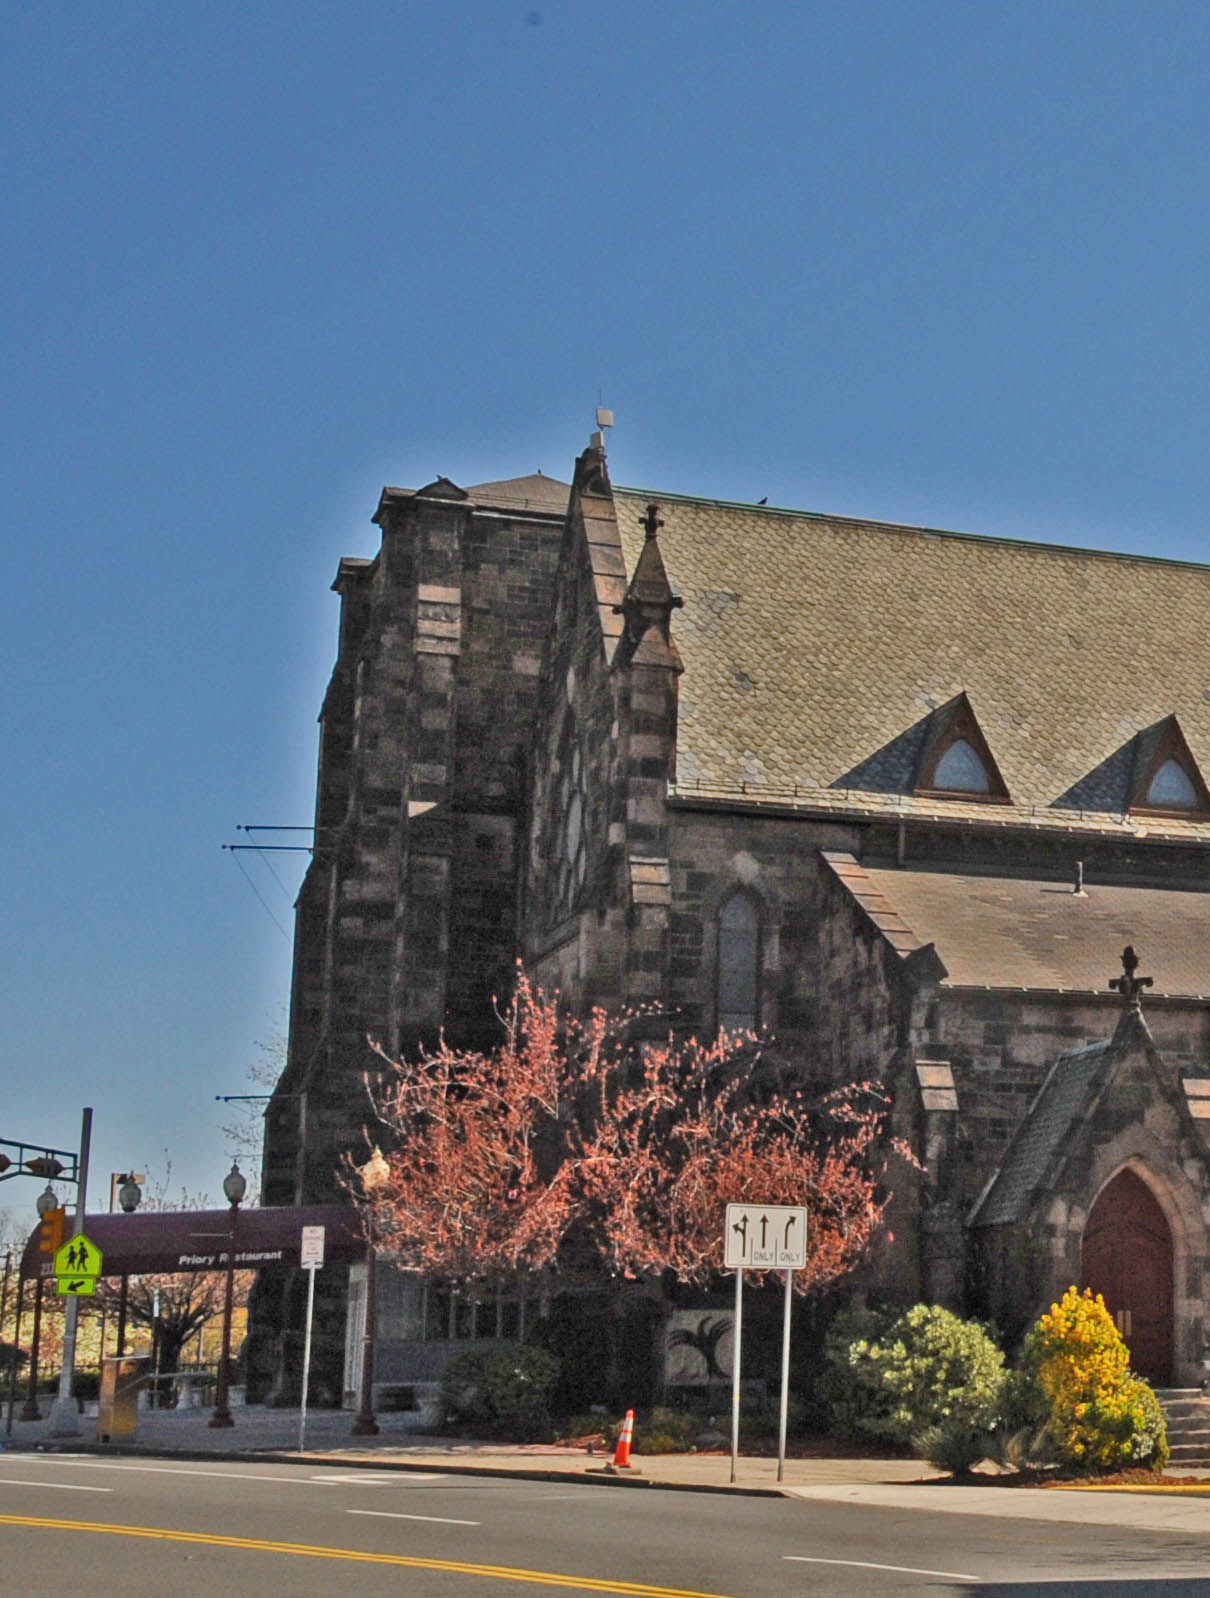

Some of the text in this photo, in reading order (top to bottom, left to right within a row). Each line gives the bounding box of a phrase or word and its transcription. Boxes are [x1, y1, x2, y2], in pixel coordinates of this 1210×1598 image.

[178, 1251, 282, 1266] Priory Rstaurant
[753, 1251, 801, 1263] ONLY ONLY
